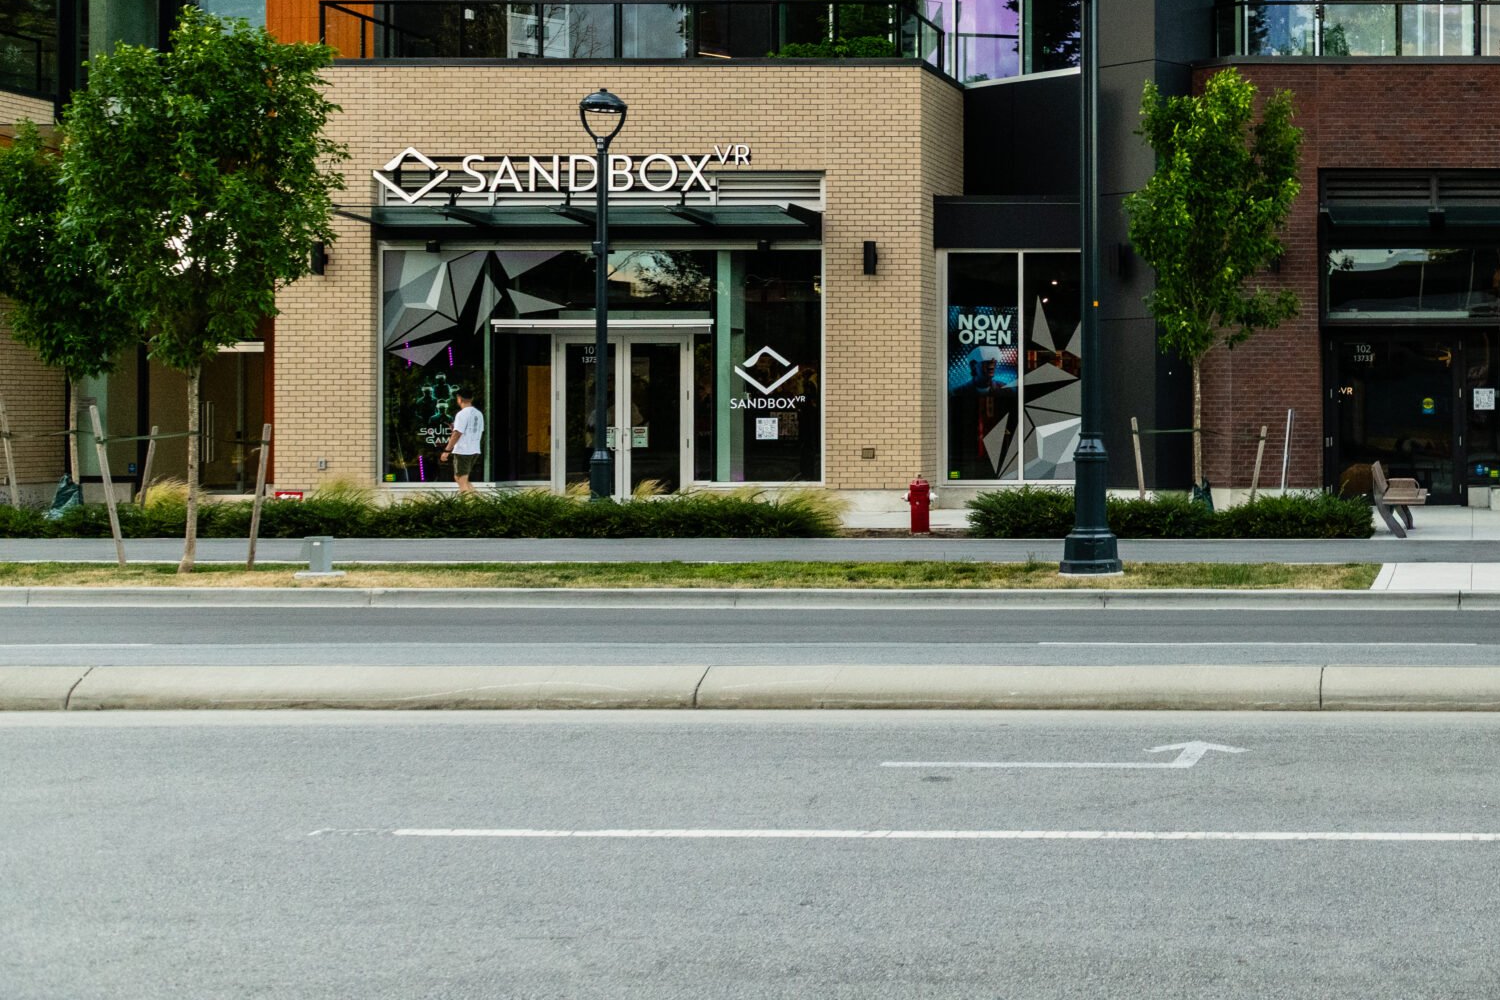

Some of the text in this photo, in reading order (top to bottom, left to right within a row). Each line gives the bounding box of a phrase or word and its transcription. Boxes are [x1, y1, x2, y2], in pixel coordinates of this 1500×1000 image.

[461, 154, 712, 192] SANDBOX
[958, 314, 1012, 331] NOW
[958, 330, 1012, 345] OPEN
[1356, 344, 1372, 353] 102
[582, 356, 597, 364] 1373
[1353, 354, 1374, 362] 13733
[730, 397, 796, 409] SANDBOX
[425, 437, 451, 447] GAM
